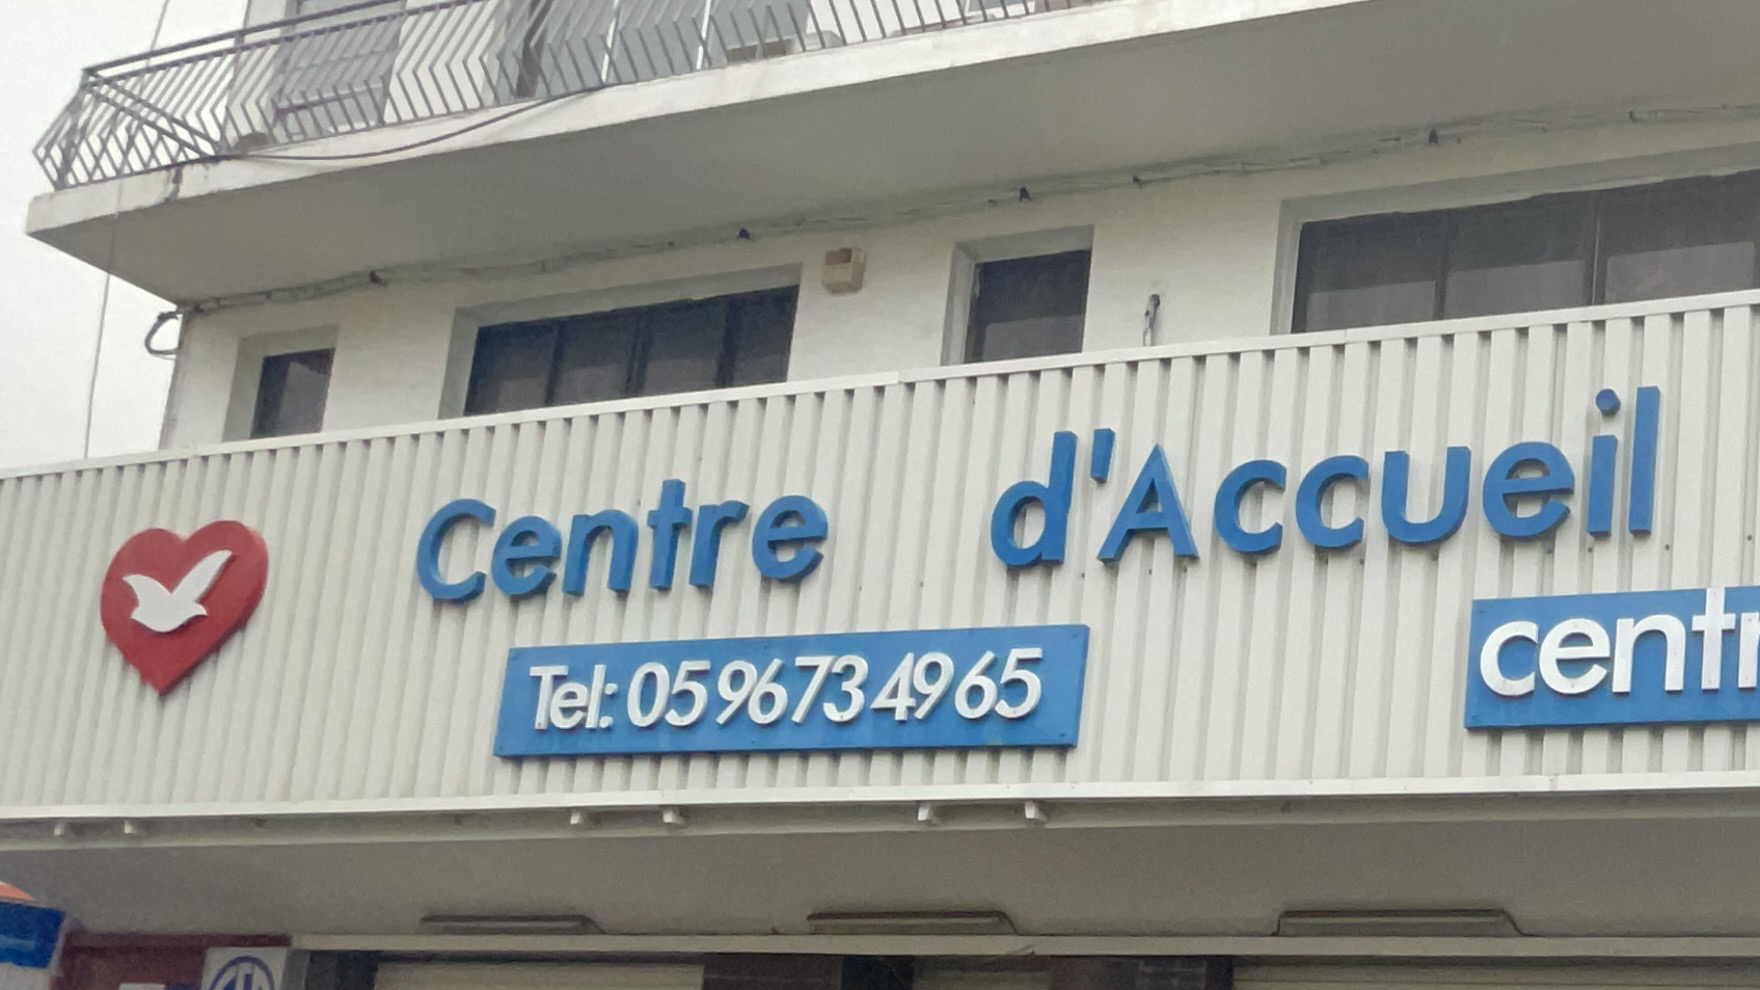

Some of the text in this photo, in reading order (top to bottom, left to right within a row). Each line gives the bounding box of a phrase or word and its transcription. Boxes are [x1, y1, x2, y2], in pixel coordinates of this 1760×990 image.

[416, 478, 828, 602] Centre
[990, 384, 1660, 568] d'Accueil
[528, 663, 613, 731] Tel:
